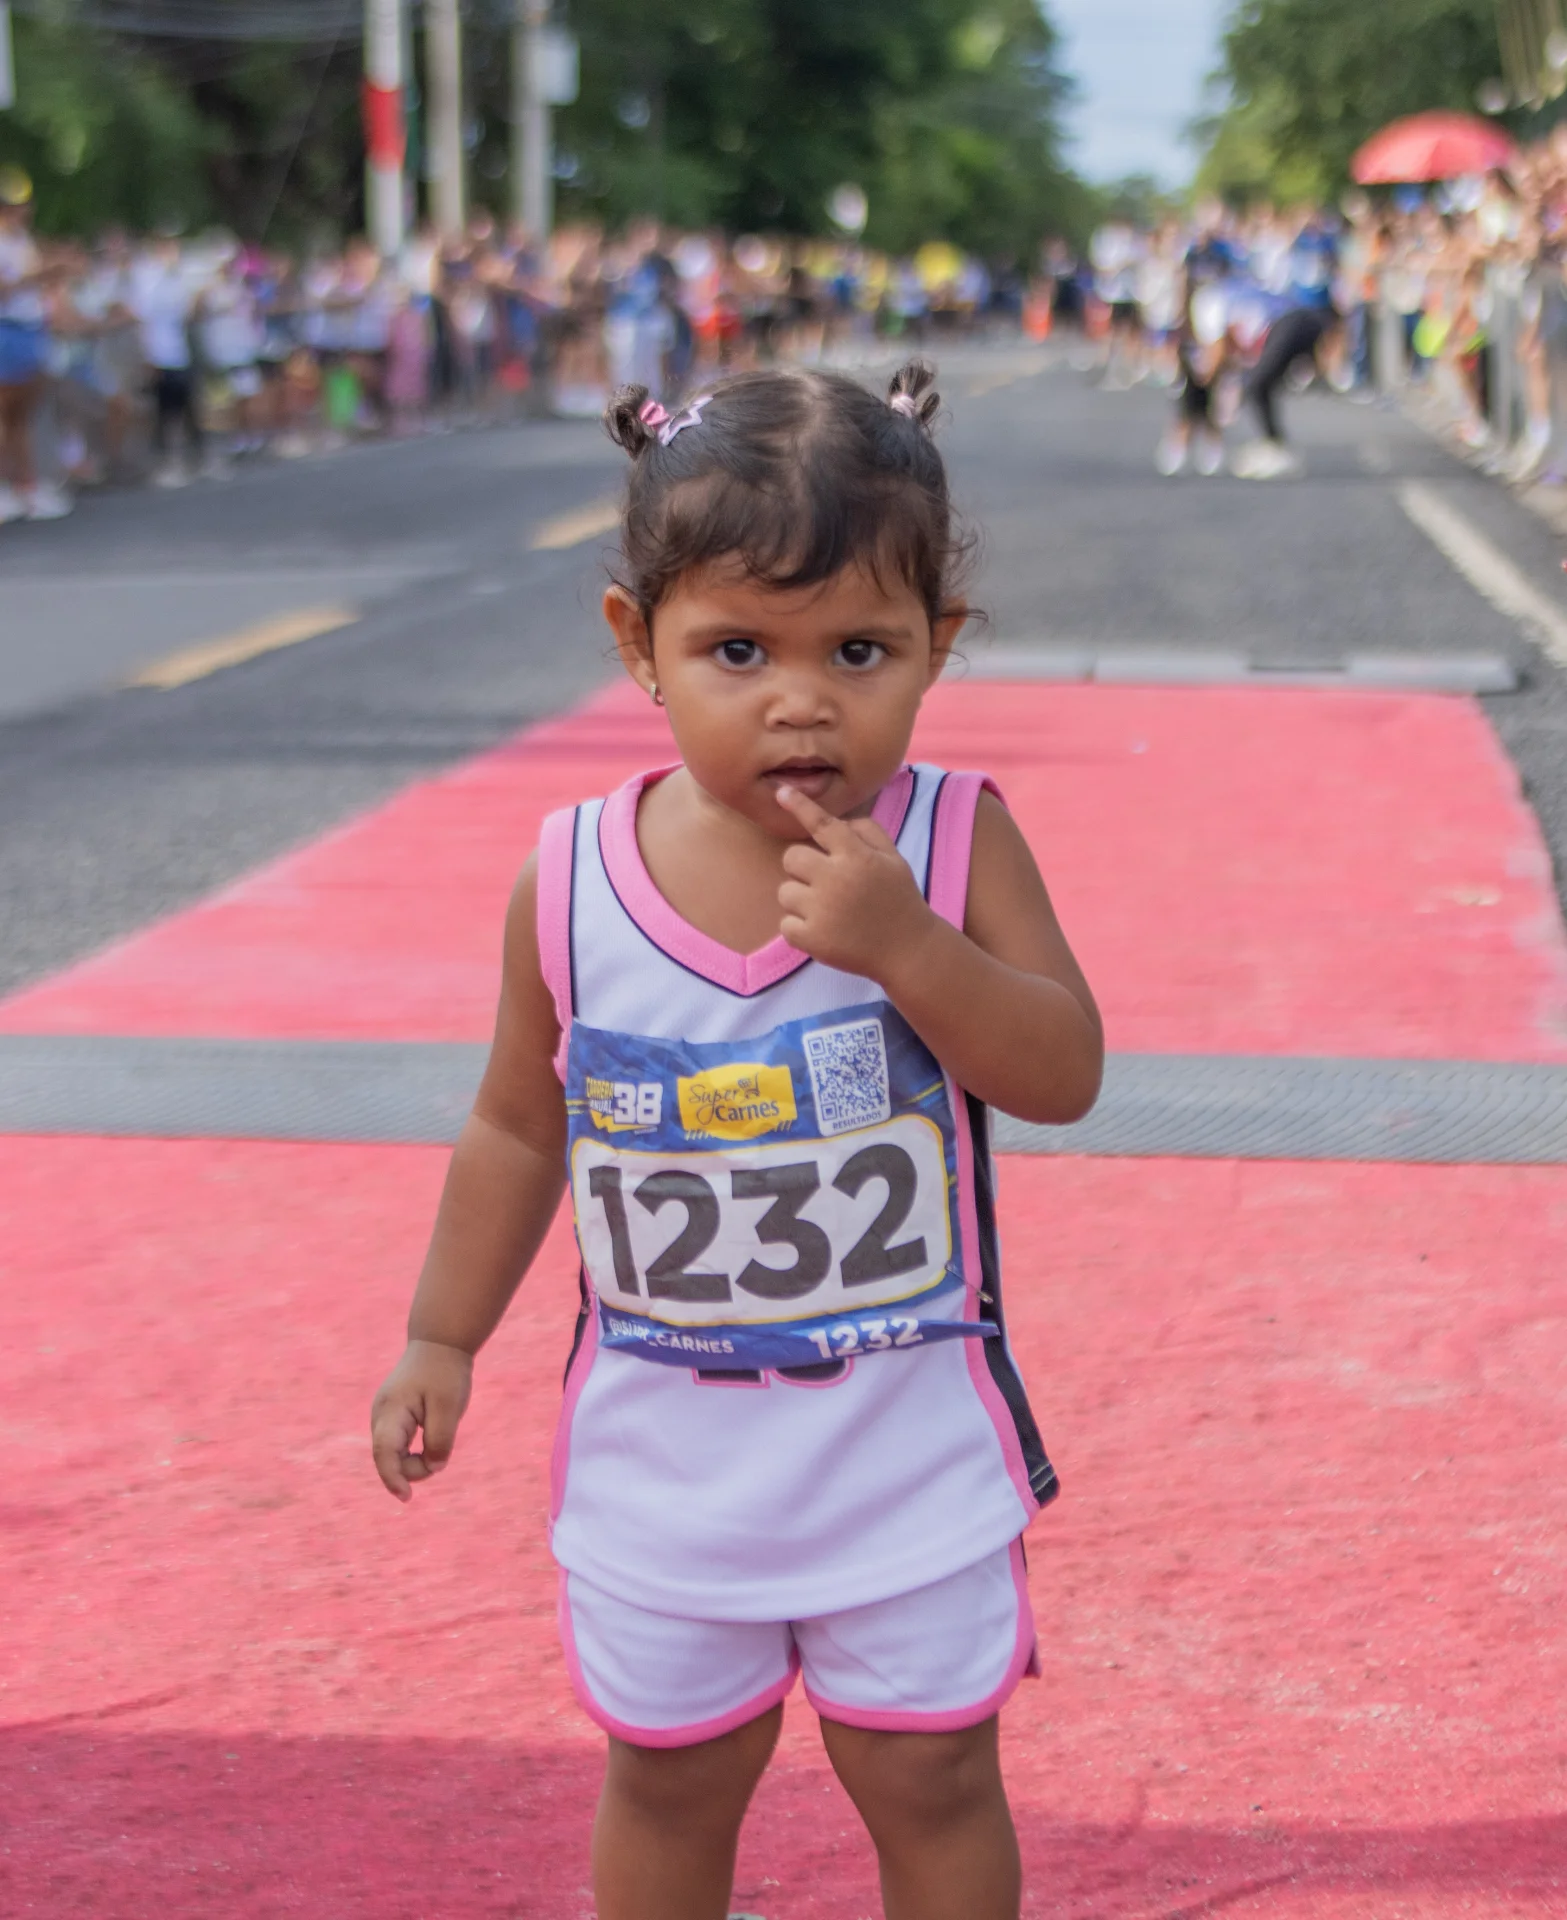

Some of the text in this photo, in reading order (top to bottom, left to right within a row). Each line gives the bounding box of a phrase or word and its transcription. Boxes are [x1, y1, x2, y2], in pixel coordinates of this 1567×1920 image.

[613, 1083, 663, 1125] 38
[688, 1084, 738, 1126] Super
[715, 1100, 780, 1122] Carnes
[832, 1111, 882, 1130] RESULTADOS
[588, 1143, 929, 1304] 1232
[808, 1316, 924, 1359] 1232
